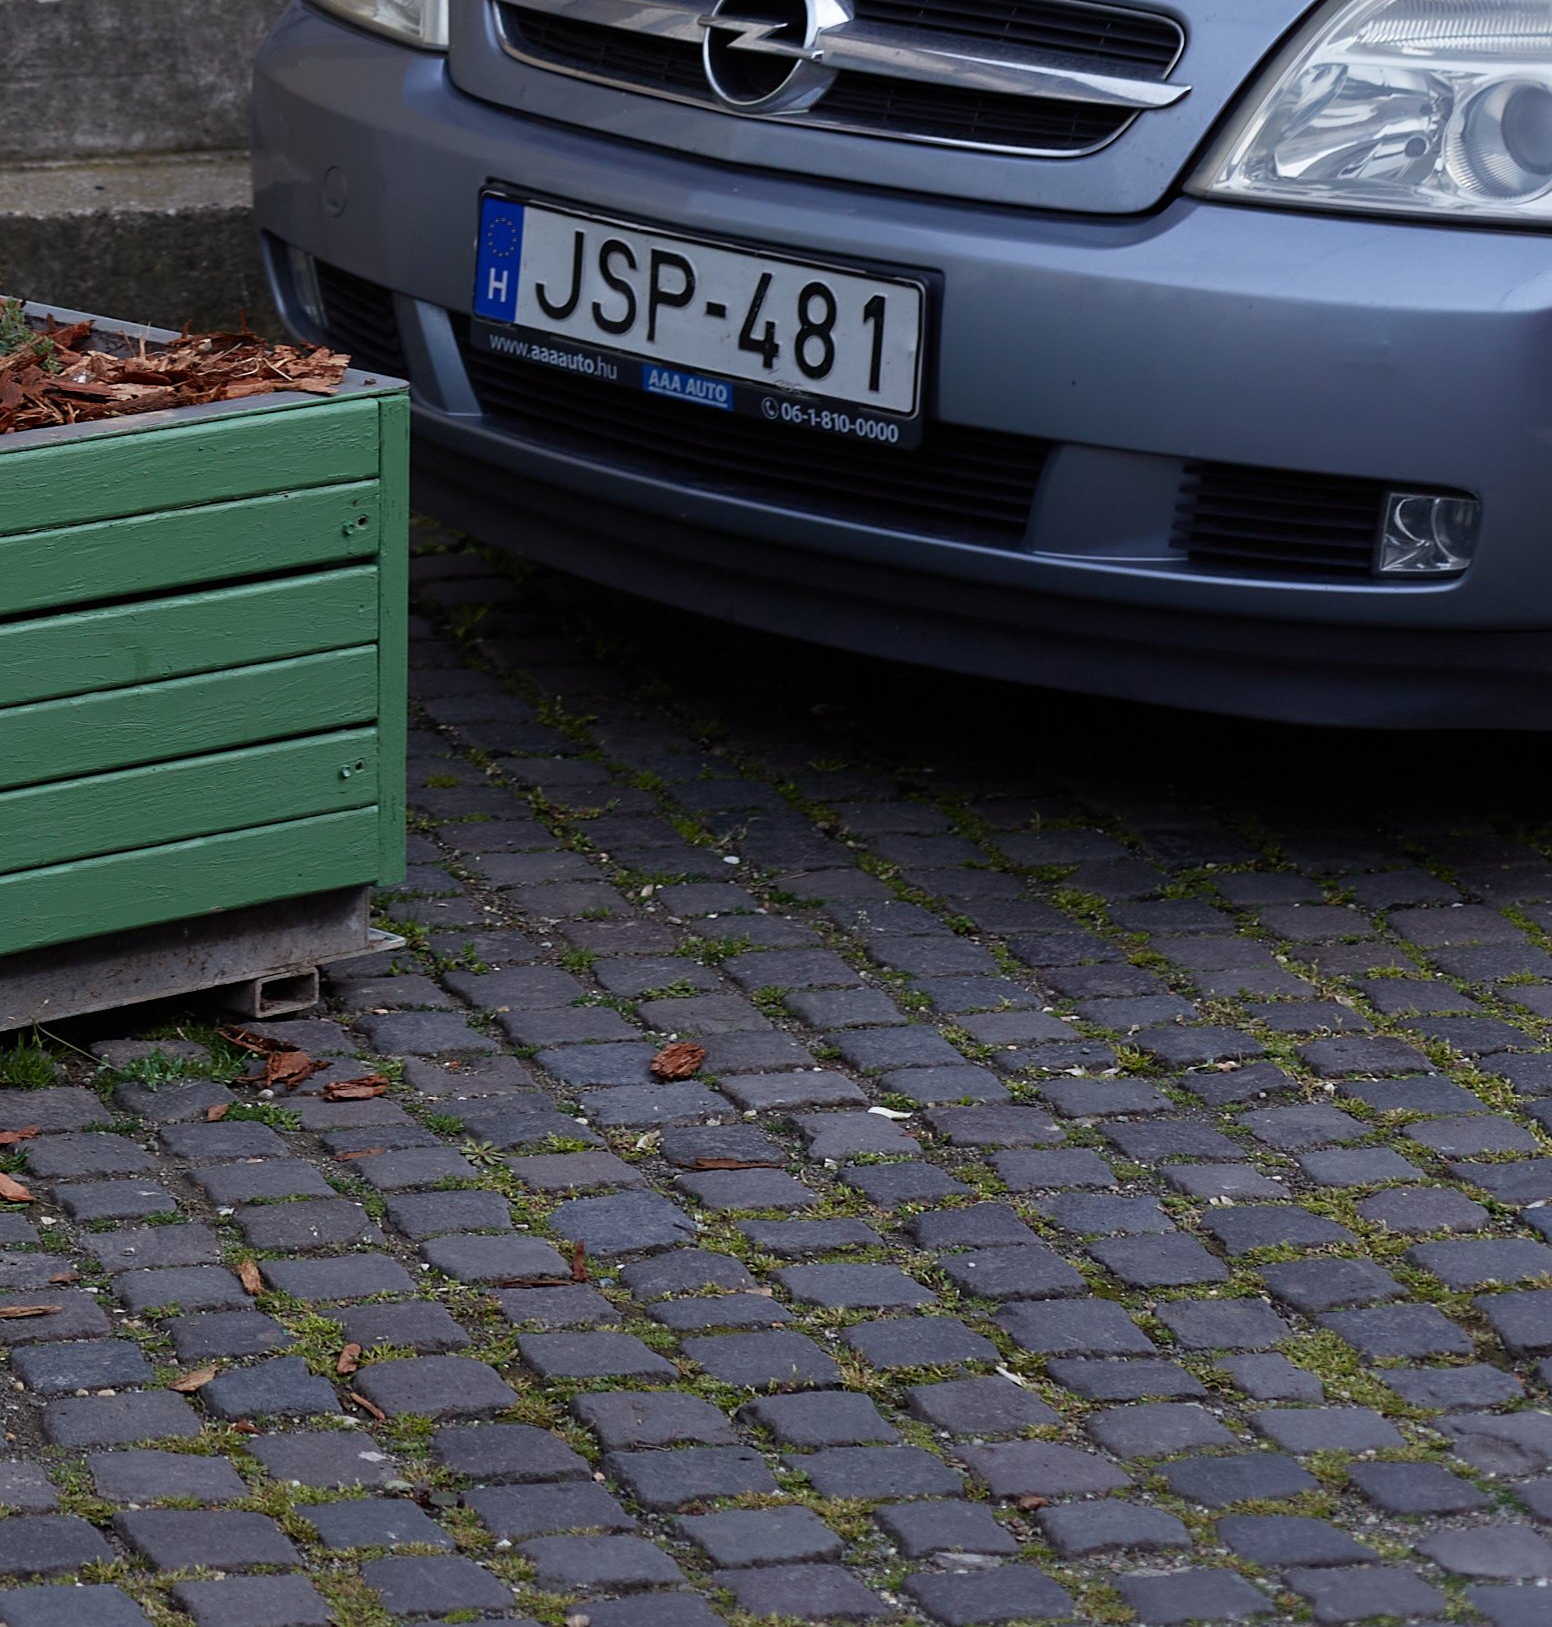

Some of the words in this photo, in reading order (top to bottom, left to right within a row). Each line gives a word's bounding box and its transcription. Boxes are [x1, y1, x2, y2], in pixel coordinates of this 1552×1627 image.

[487, 267, 508, 303] H
[534, 230, 886, 392] JSP-481
[489, 334, 618, 380] www.aaaauto.hu
[648, 369, 681, 392] AAA
[685, 378, 728, 402] AUTO
[780, 402, 899, 443] 06-1-810-0000
